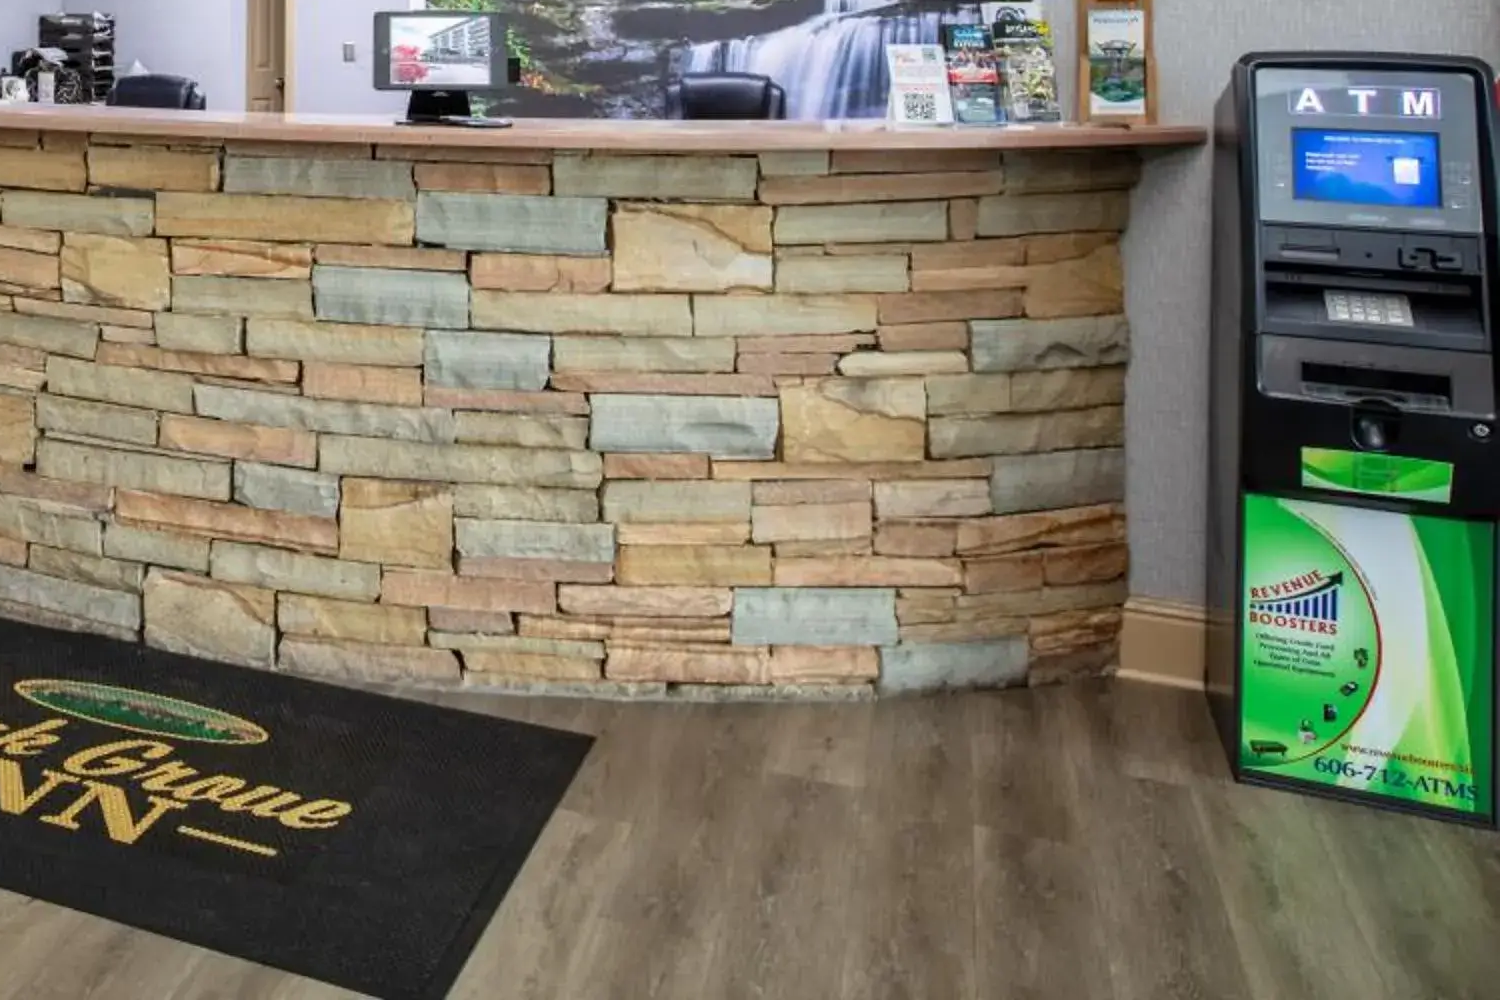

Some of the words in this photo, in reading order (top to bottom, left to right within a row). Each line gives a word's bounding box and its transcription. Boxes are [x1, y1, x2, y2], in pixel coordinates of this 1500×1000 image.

[1296, 87, 1434, 117] ATM
[1251, 569, 1323, 599] REVENUE
[1250, 611, 1338, 636] BOOSTERS
[64, 738, 352, 830] Grove
[1313, 756, 1479, 800] 606-712-ATMS
